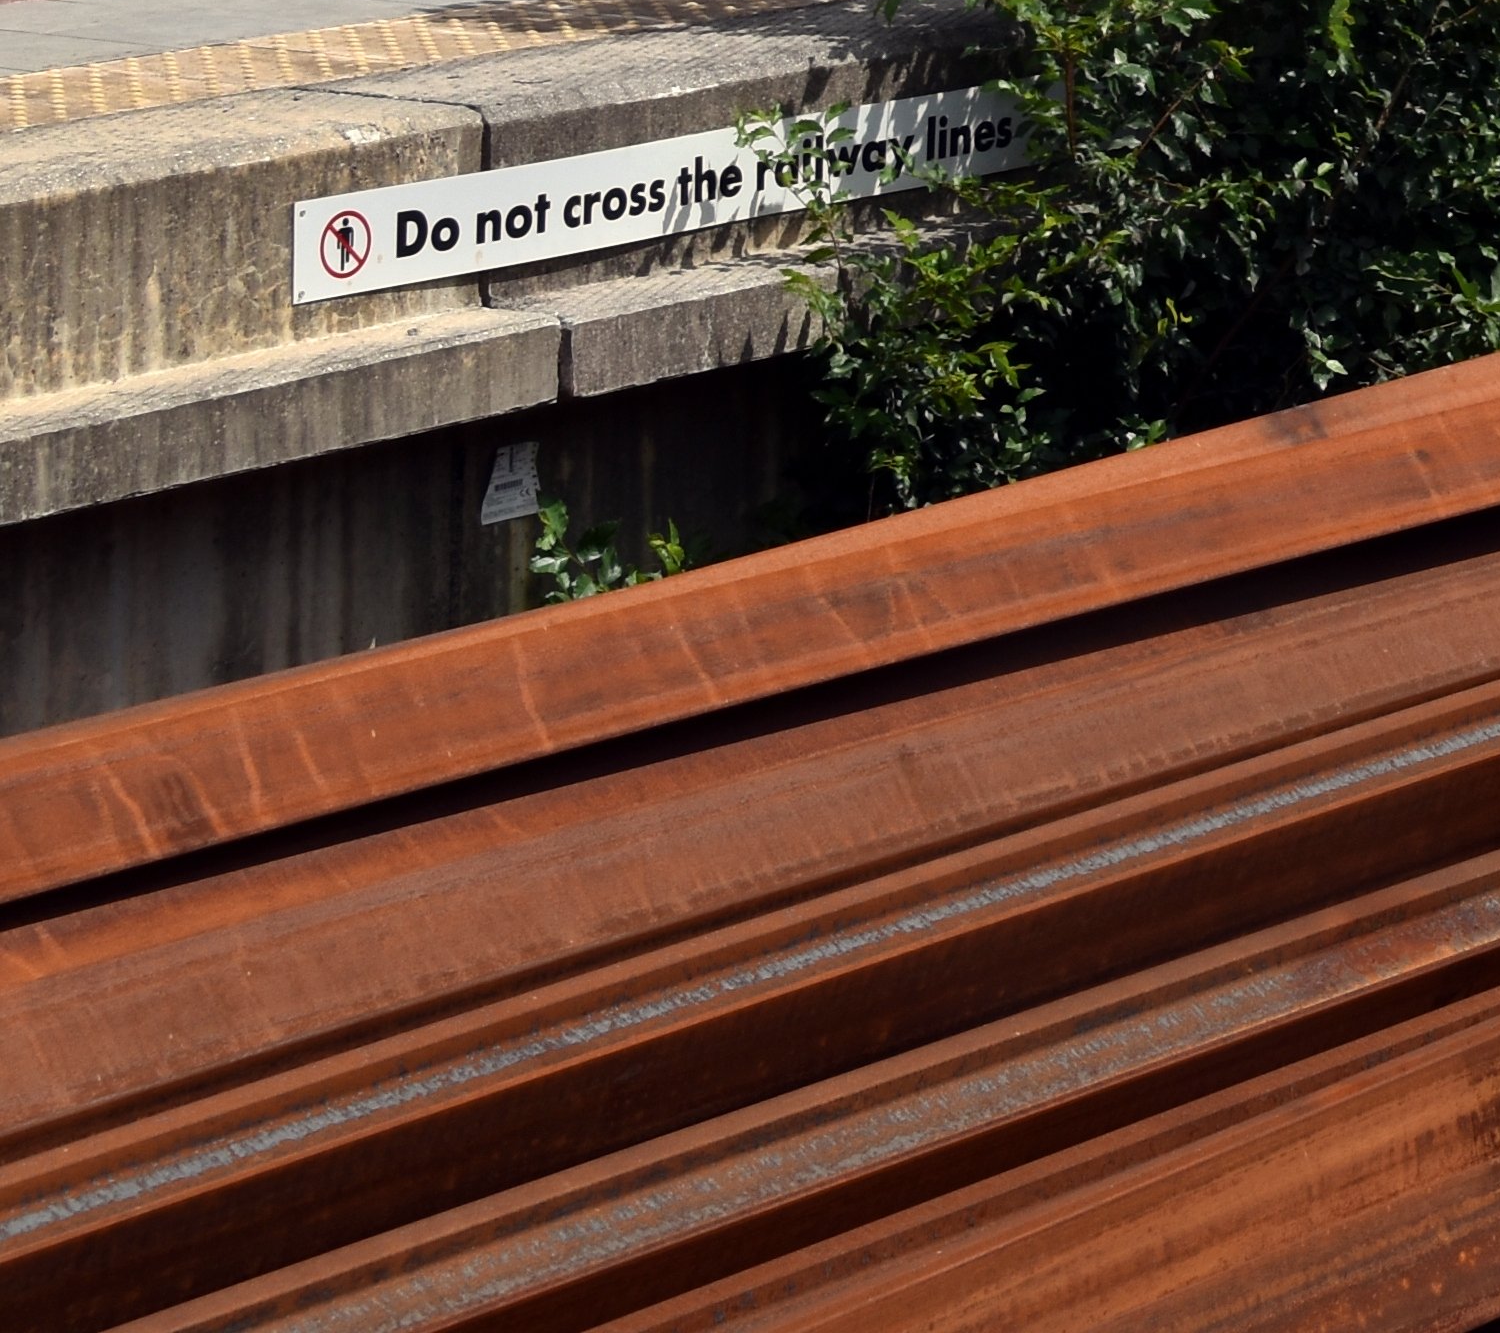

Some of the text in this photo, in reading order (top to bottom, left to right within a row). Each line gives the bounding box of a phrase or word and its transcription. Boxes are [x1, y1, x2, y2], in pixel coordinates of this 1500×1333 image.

[396, 209, 460, 259] Do
[476, 193, 551, 245] not
[563, 177, 667, 229] cross
[678, 156, 742, 206] the
[926, 115, 1012, 162] lines
